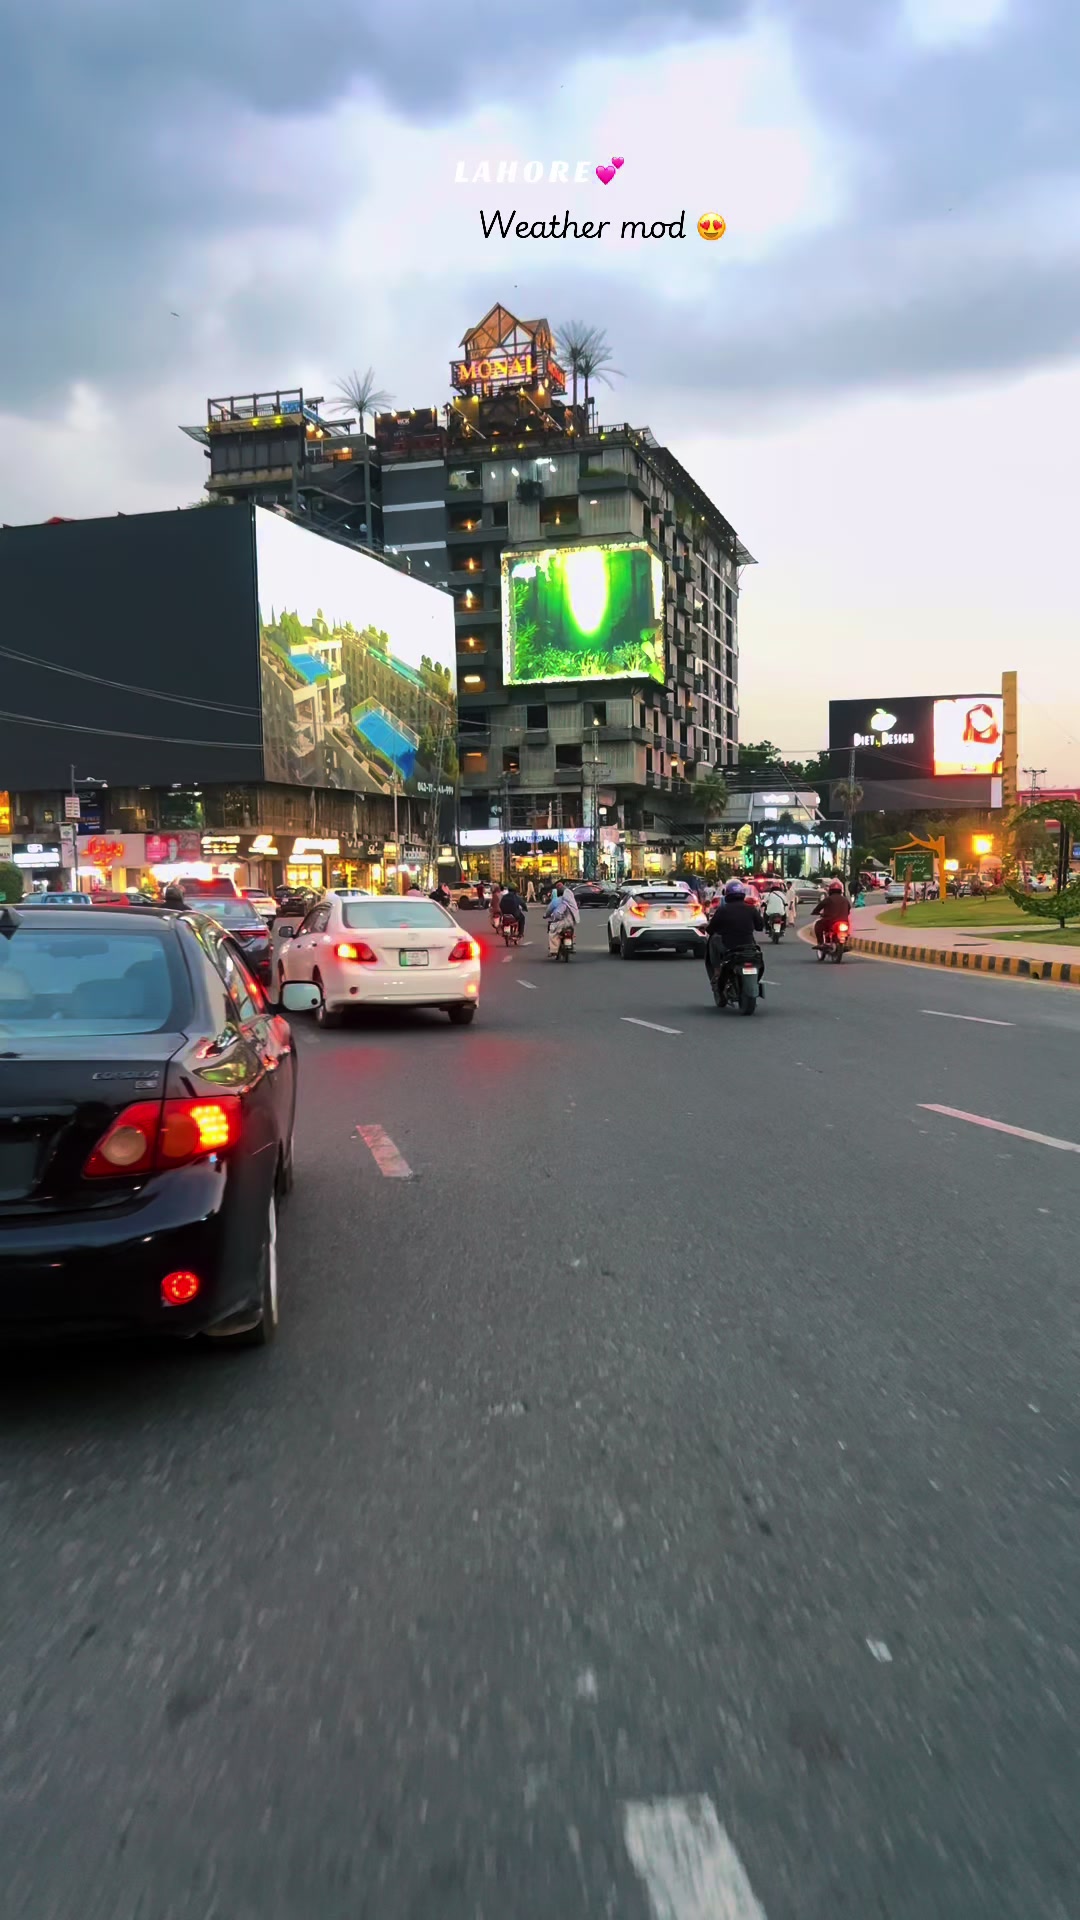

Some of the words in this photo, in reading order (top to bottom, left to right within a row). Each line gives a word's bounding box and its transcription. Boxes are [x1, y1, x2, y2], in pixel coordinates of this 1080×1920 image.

[458, 354, 538, 381] MONAL
[853, 732, 875, 747] DIET
[881, 731, 915, 746] DESIGN
